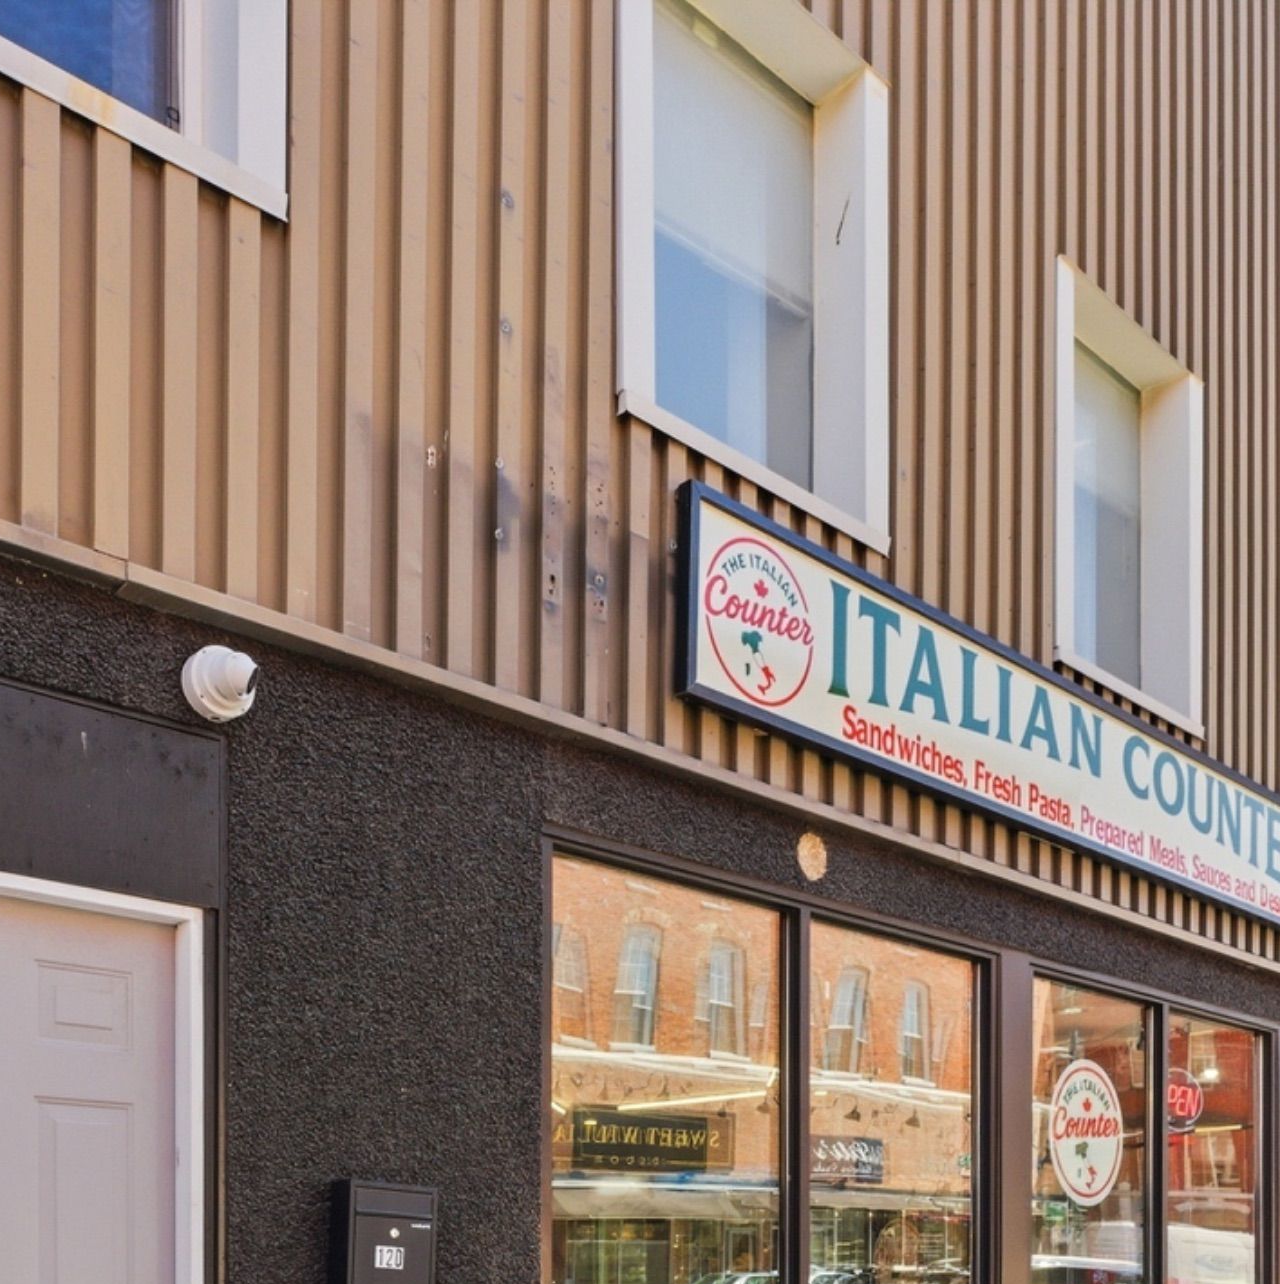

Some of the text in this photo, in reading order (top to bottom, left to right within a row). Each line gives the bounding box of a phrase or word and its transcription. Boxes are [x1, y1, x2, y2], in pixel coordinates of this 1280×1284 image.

[704, 574, 814, 646] Counter
[721, 552, 800, 608] THE ITALIAN
[827, 578, 1102, 778] ITALIAN
[842, 704, 968, 788] Sandwiches,
[974, 759, 1022, 806] Fresh
[1080, 805, 1145, 857] Prepared
[1193, 857, 1231, 890] Sauces
[1235, 876, 1255, 902] and
[1054, 1106, 1120, 1140] Counter
[1168, 1084, 1201, 1117] PEN
